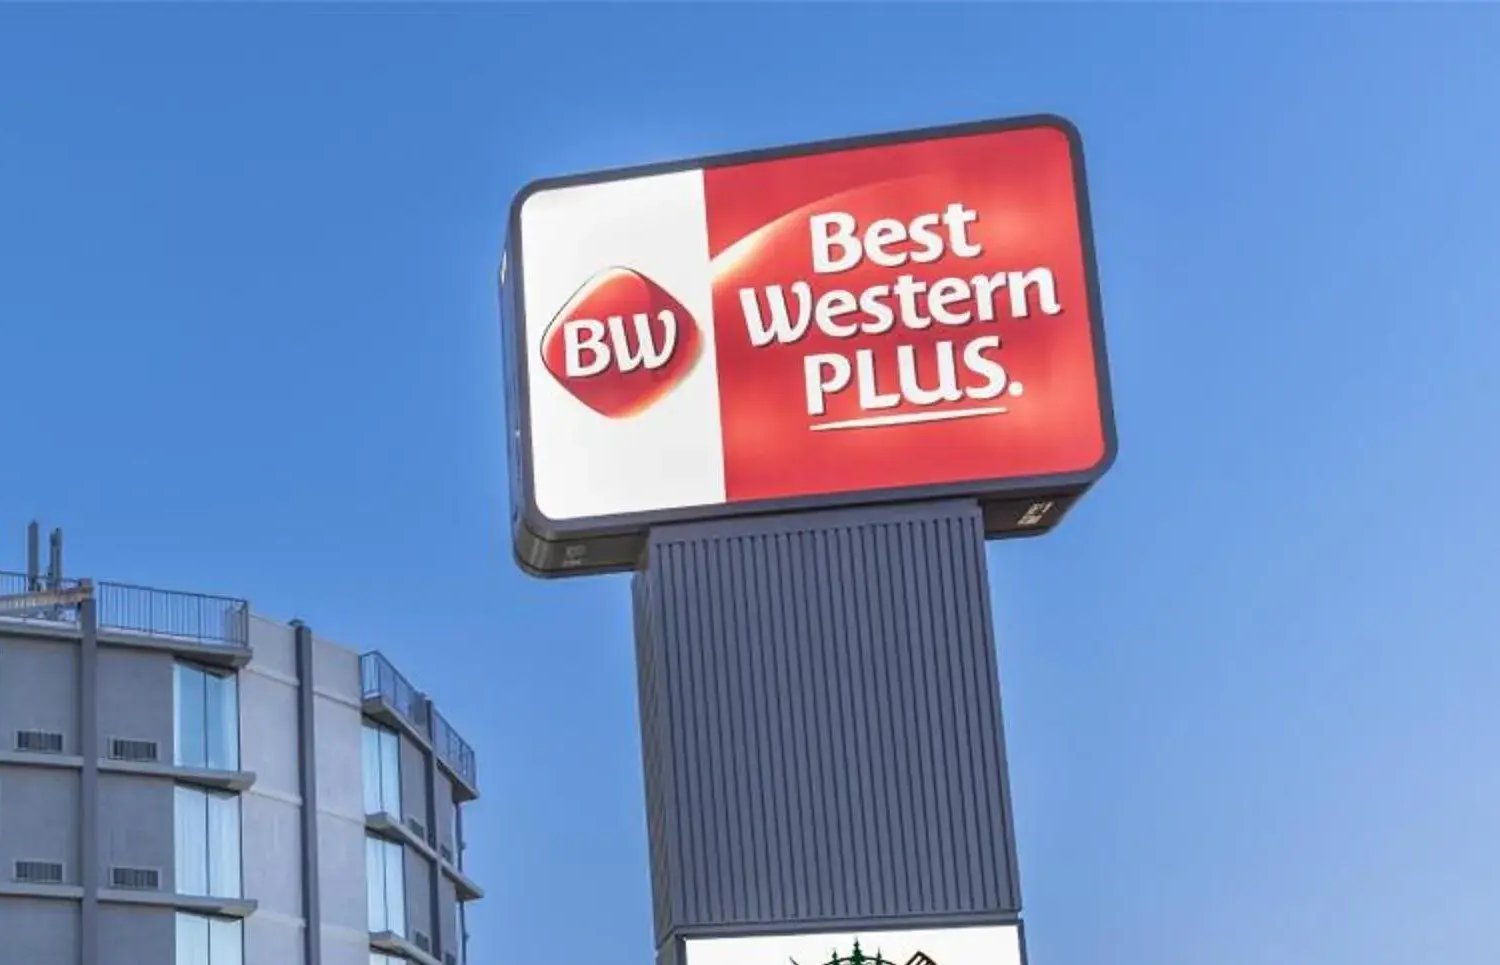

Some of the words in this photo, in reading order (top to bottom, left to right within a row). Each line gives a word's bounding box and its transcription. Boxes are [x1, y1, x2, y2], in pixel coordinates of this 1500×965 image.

[809, 203, 982, 273] Best
[739, 267, 1061, 346] Western
[563, 309, 676, 377] BW
